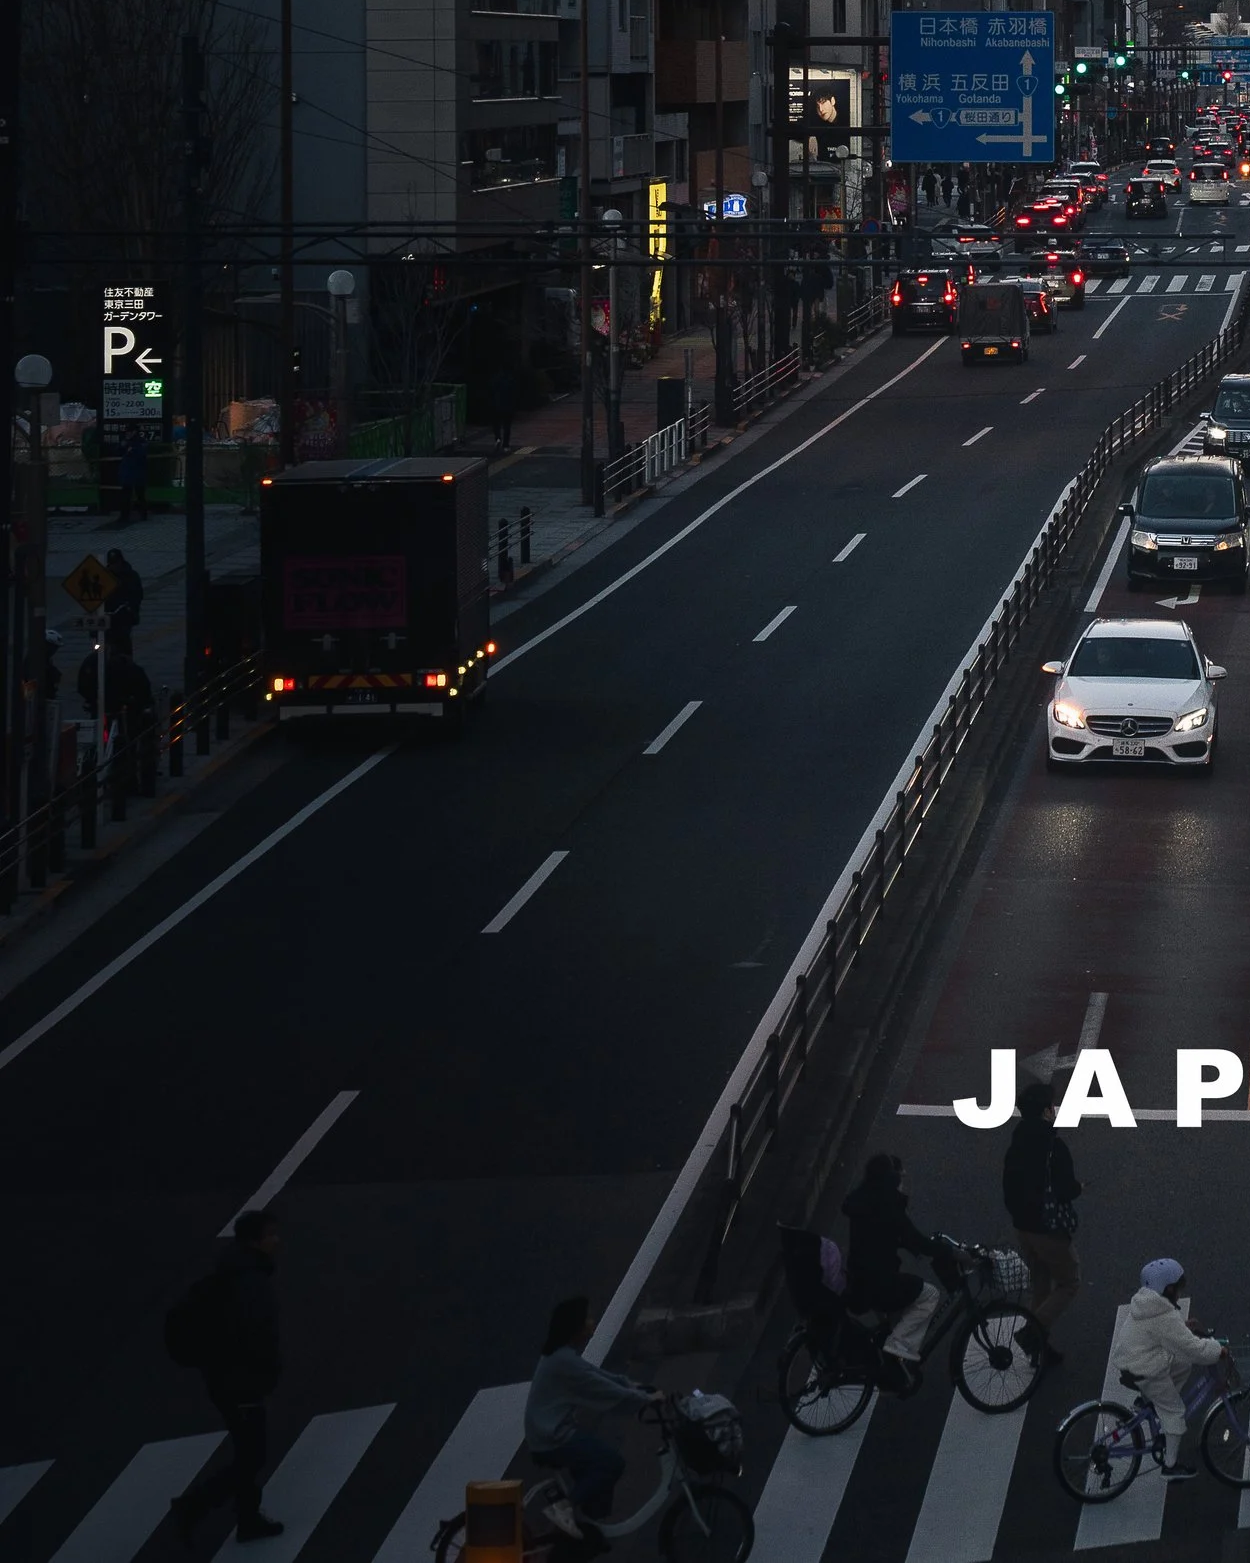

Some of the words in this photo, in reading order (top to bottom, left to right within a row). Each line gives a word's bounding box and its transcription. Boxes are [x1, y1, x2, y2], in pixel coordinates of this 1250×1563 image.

[920, 17, 978, 35] 日本橋
[988, 17, 1047, 35] 赤羽橋
[920, 38, 976, 47] Nihonbashi
[985, 38, 1050, 47] Akabanebashi
[898, 74, 941, 91] 横浜
[950, 74, 1009, 91] 五反田
[1024, 79, 1030, 90] 1
[896, 94, 943, 103] Yokohama
[958, 94, 1002, 103] Gotanda
[937, 110, 943, 122] 1
[964, 111, 1011, 122] 桜田通り
[104, 287, 154, 297] 住友不動産
[104, 300, 144, 309] 東京三田
[104, 312, 163, 321] ガーデンタワー
[104, 327, 136, 374] P
[145, 381, 162, 397] 空
[1119, 747, 1143, 755] 58-62
